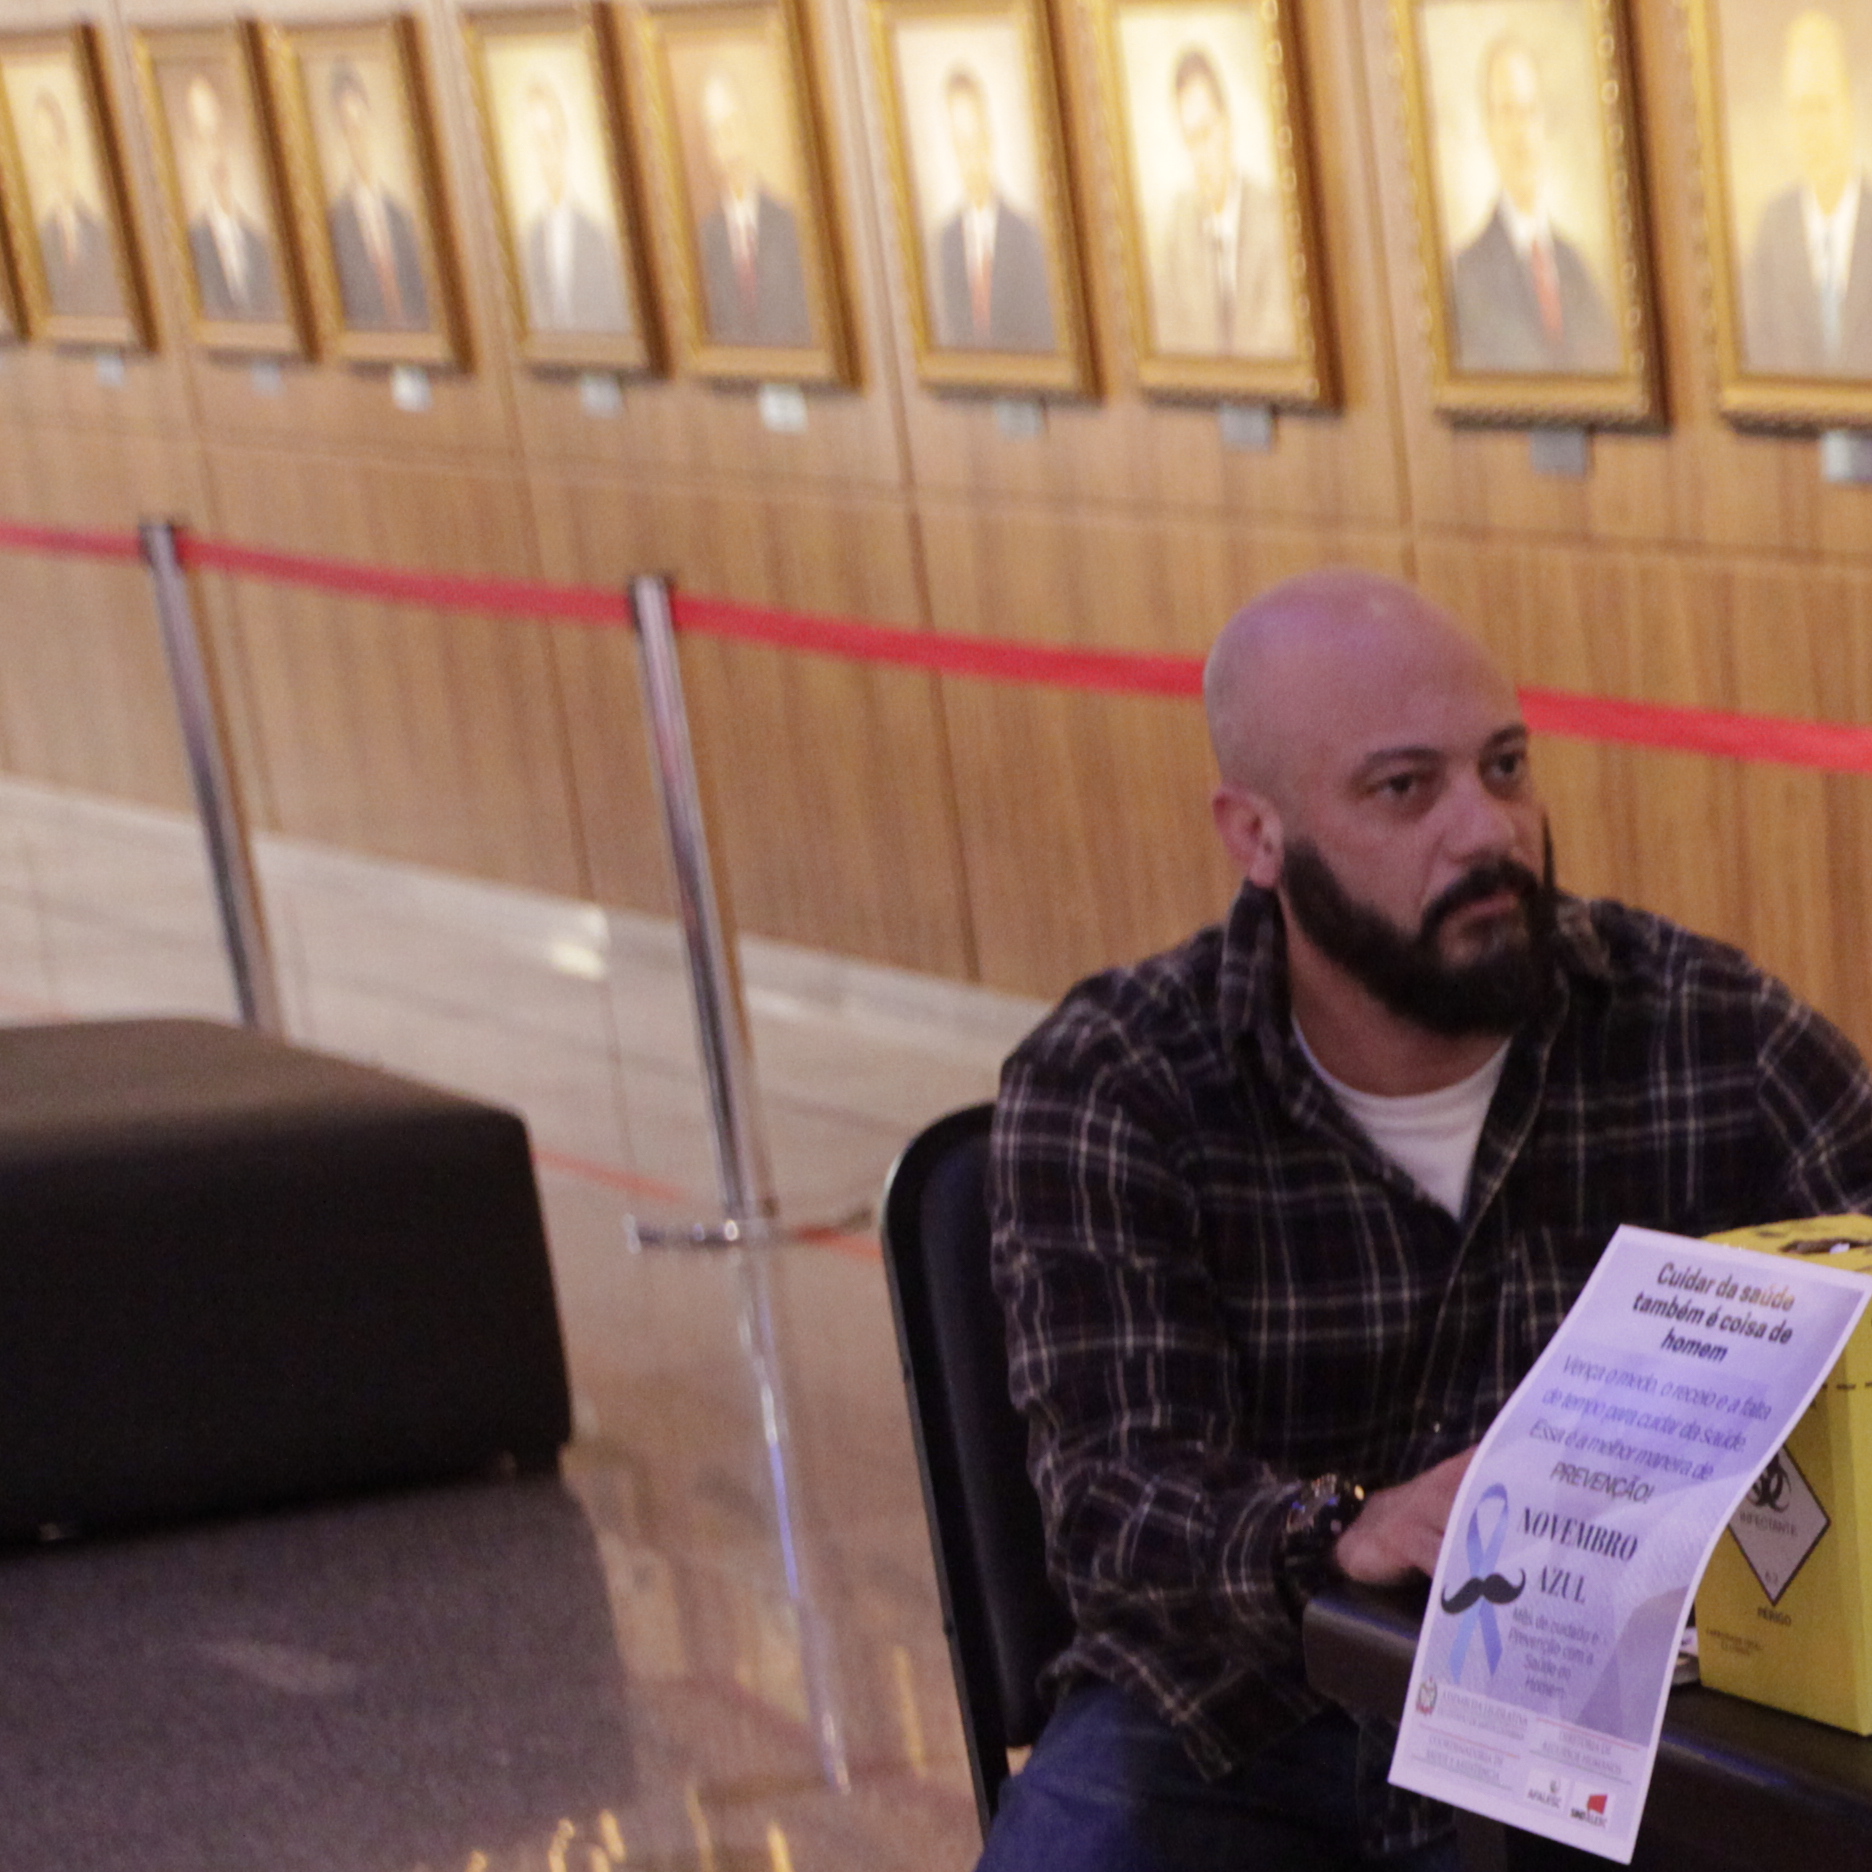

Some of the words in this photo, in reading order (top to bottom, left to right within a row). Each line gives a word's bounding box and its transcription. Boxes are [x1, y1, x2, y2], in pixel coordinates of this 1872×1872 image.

[1656, 1262, 1715, 1293] Cuidar
[1715, 1275, 1736, 1299] da
[1739, 1284, 1795, 1312] saúde
[1632, 1291, 1704, 1325] também
[1705, 1305, 1721, 1328] é
[1720, 1312, 1766, 1338] coisa
[1768, 1320, 1793, 1345] de
[1661, 1328, 1728, 1363] homem
[1542, 1387, 1562, 1404] de
[1561, 1392, 1602, 1421] tempo
[1679, 1420, 1701, 1443] da
[1604, 1367, 1618, 1384] o
[1660, 1381, 1673, 1397] o
[1727, 1396, 1739, 1414] a
[1737, 1394, 1772, 1422] falta
[1530, 1417, 1565, 1443] Essa
[1692, 1461, 1714, 1481] de
[1551, 1461, 1656, 1504] PREVENÇÃO!
[1517, 1506, 1638, 1561] NOVEMBRO
[1538, 1564, 1586, 1604] AZUL
[1757, 1606, 1793, 1627] PERIGO
